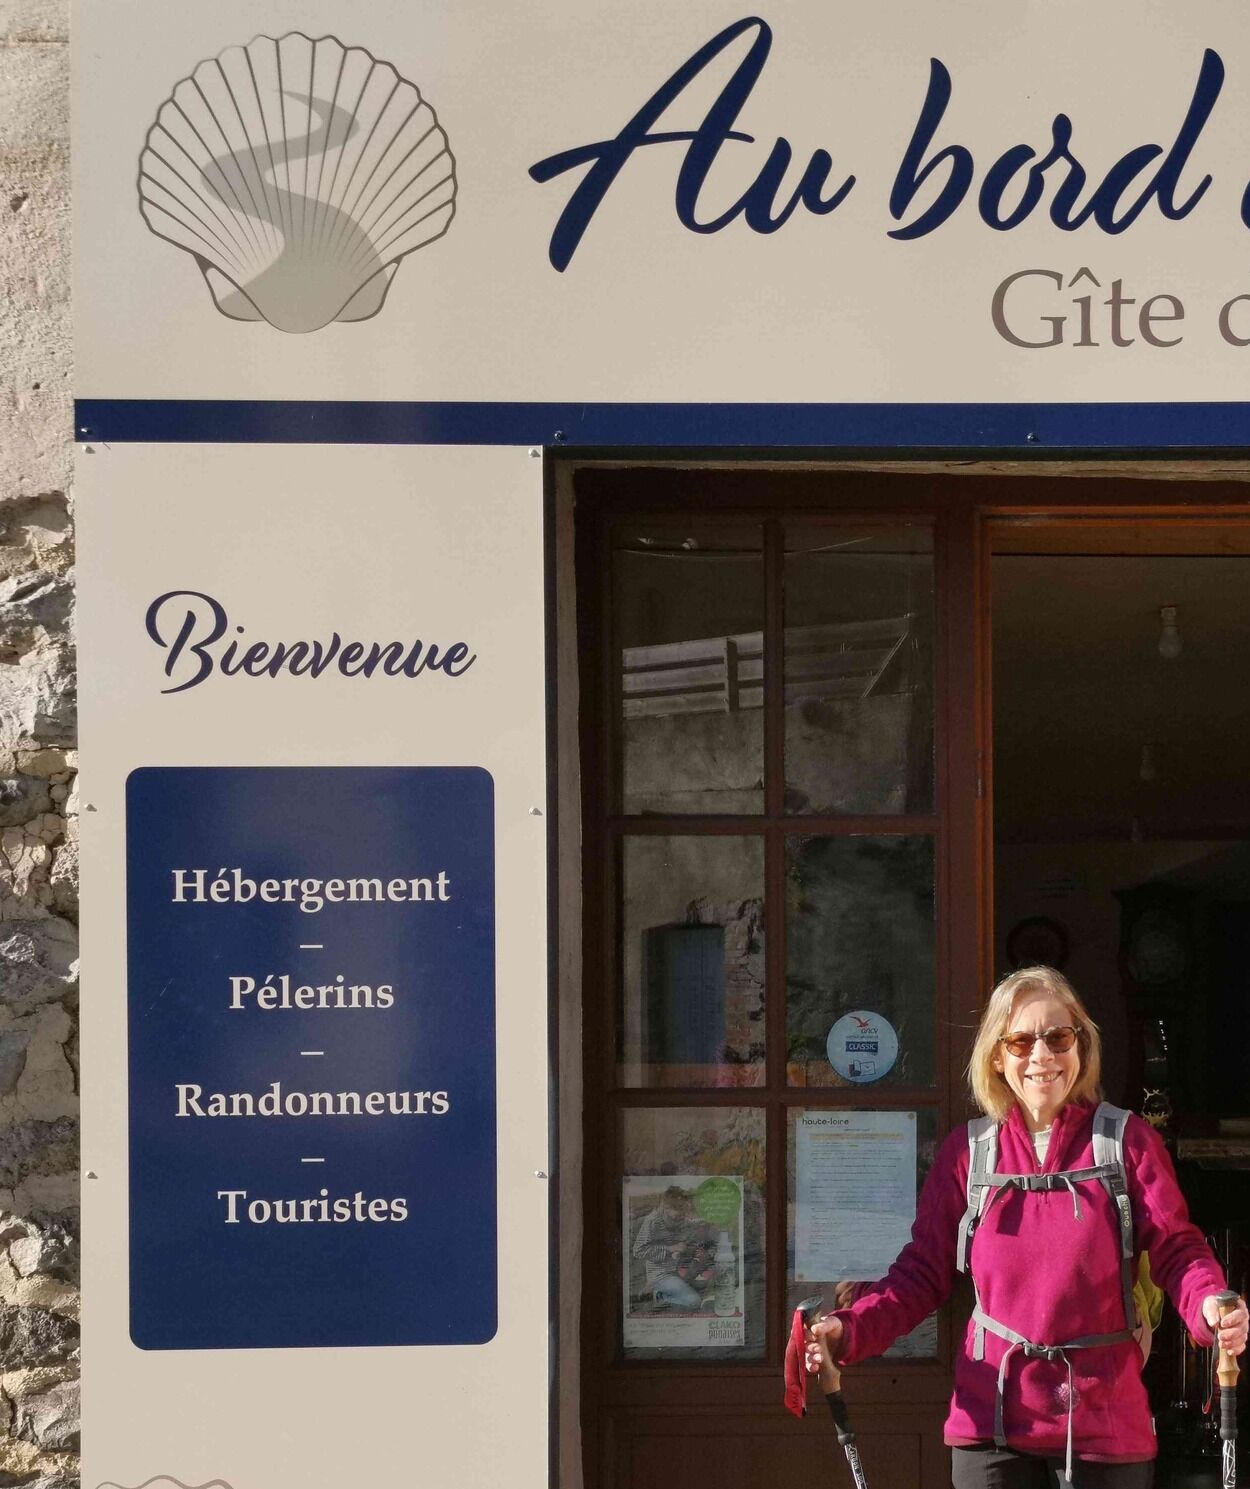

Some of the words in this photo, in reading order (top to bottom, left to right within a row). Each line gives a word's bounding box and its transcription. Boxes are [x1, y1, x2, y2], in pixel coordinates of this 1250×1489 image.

[528, 16, 856, 273] Au
[887, 48, 1225, 240] bord
[990, 267, 1186, 349] Gîte
[145, 590, 477, 694] Bienvenue
[171, 868, 451, 912] Hébergement
[228, 975, 394, 1010] Pélerins
[848, 1043, 877, 1051] CLASSIC
[174, 1083, 450, 1118] Randonneurs
[802, 1117, 849, 1126] haute-loire
[217, 1190, 408, 1224] Touristes
